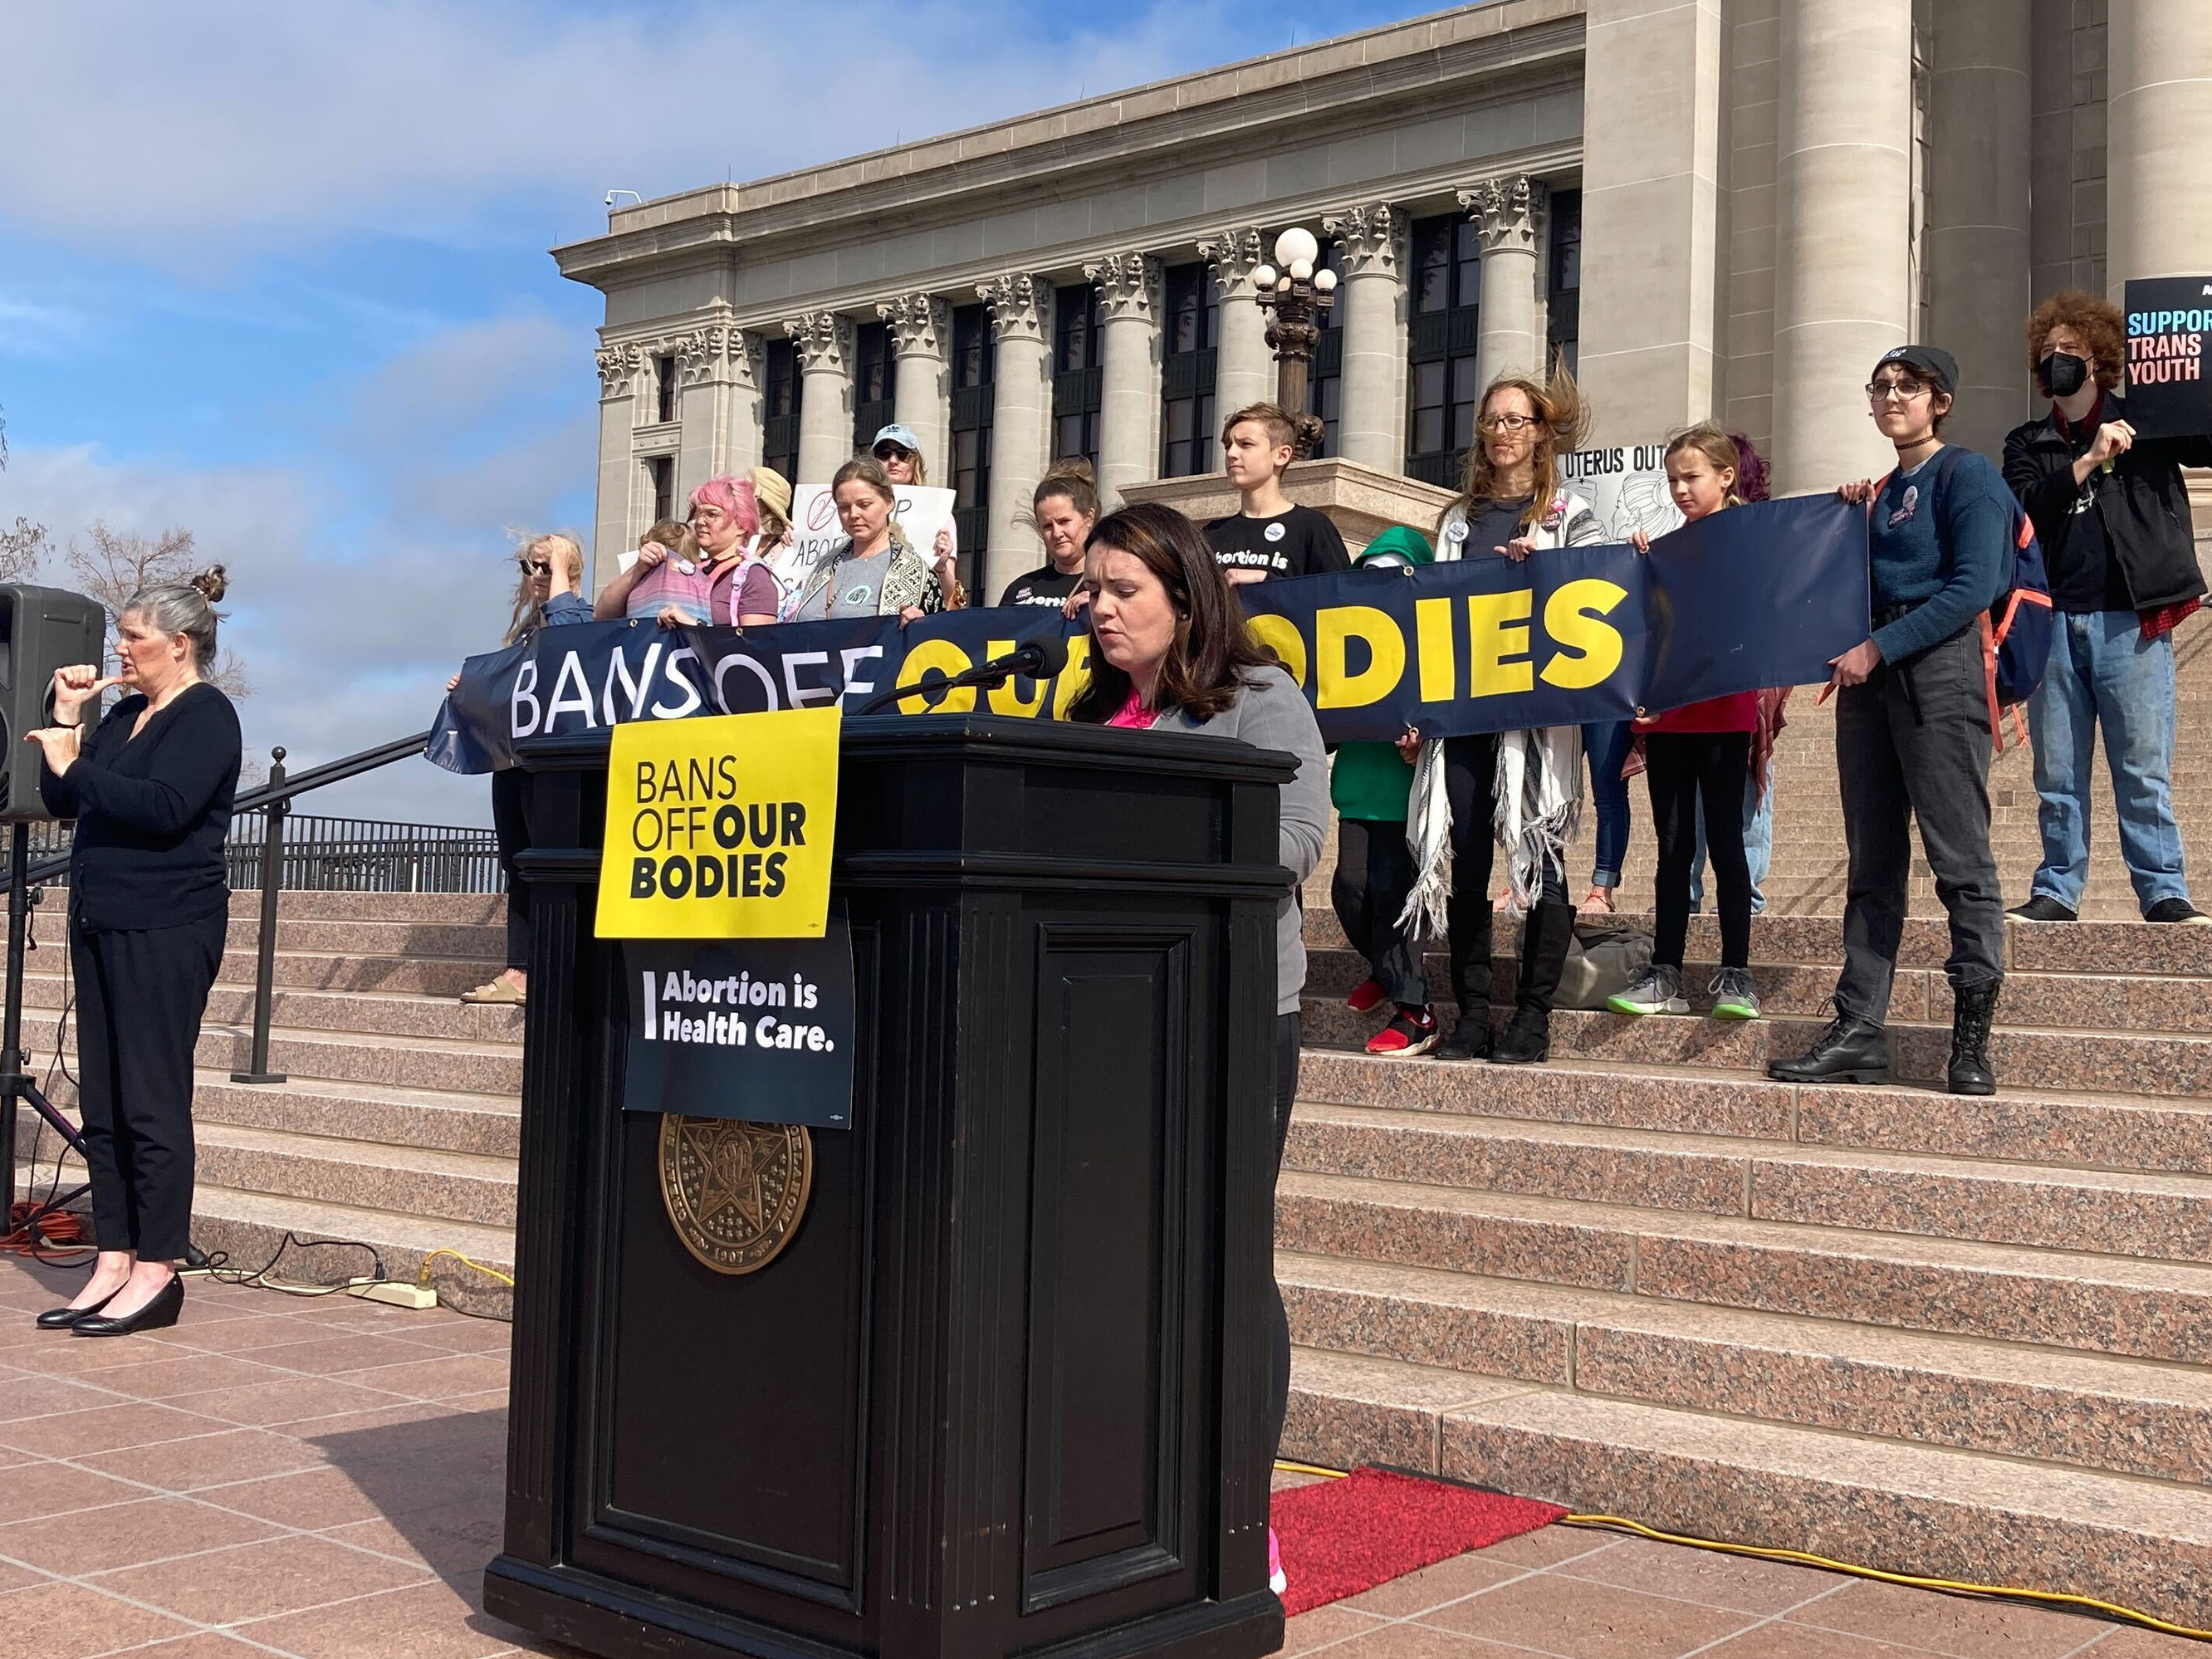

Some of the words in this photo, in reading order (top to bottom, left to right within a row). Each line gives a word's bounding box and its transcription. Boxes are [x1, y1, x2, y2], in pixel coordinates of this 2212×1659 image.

[2127, 333, 2202, 360] TRANS
[2127, 357, 2200, 385] YOUTH
[1565, 448, 1624, 478] UTERUS
[1215, 549, 1270, 565] bortion
[1271, 551, 1289, 570] is
[511, 643, 704, 738] BANS
[713, 645, 883, 712] OFF
[1246, 578, 1628, 710] DIES
[637, 754, 737, 804] BANS
[632, 806, 707, 852] OFF
[713, 801, 806, 850] OUR
[629, 851, 789, 900] BODIES
[663, 970, 785, 1007] Abortion
[794, 972, 818, 1010] is
[663, 1011, 746, 1046] Health
[756, 1015, 834, 1052] Care.
[713, 1246, 744, 1263] 1907
